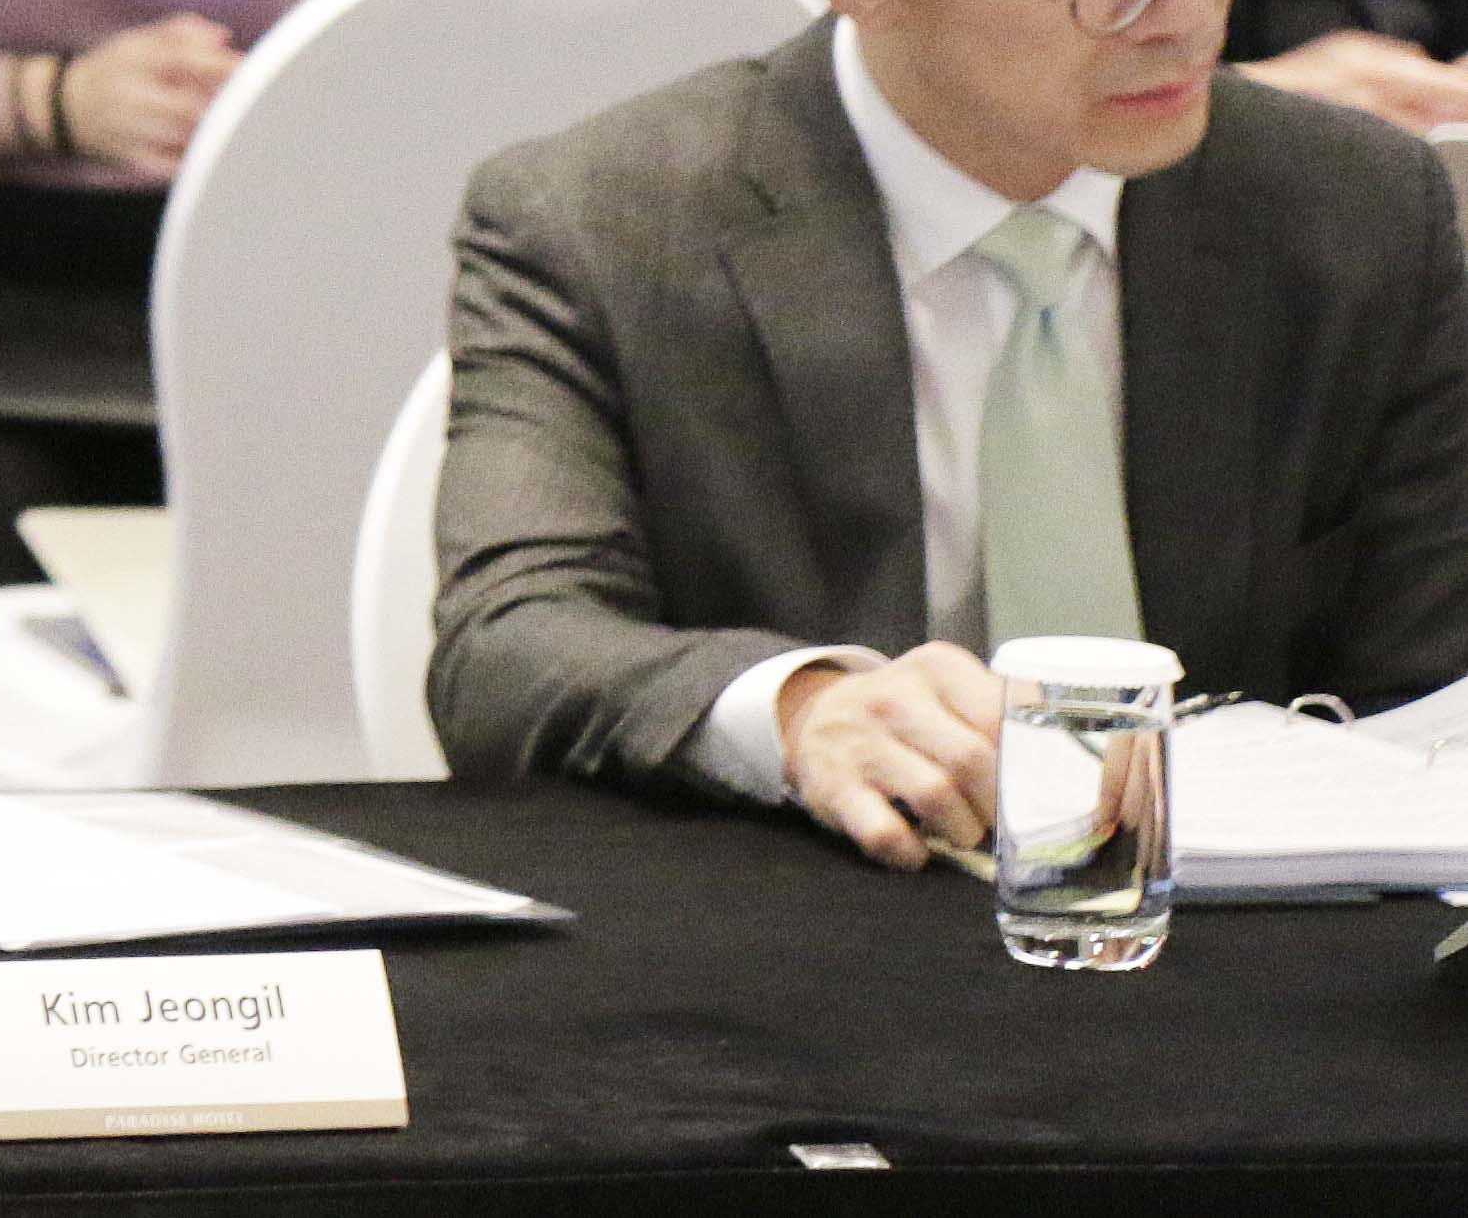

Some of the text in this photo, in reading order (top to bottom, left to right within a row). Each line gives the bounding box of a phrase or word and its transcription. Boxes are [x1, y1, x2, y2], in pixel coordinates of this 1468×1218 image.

[41, 984, 286, 1031] Kim Jeongil
[71, 1040, 273, 1069] Director General
